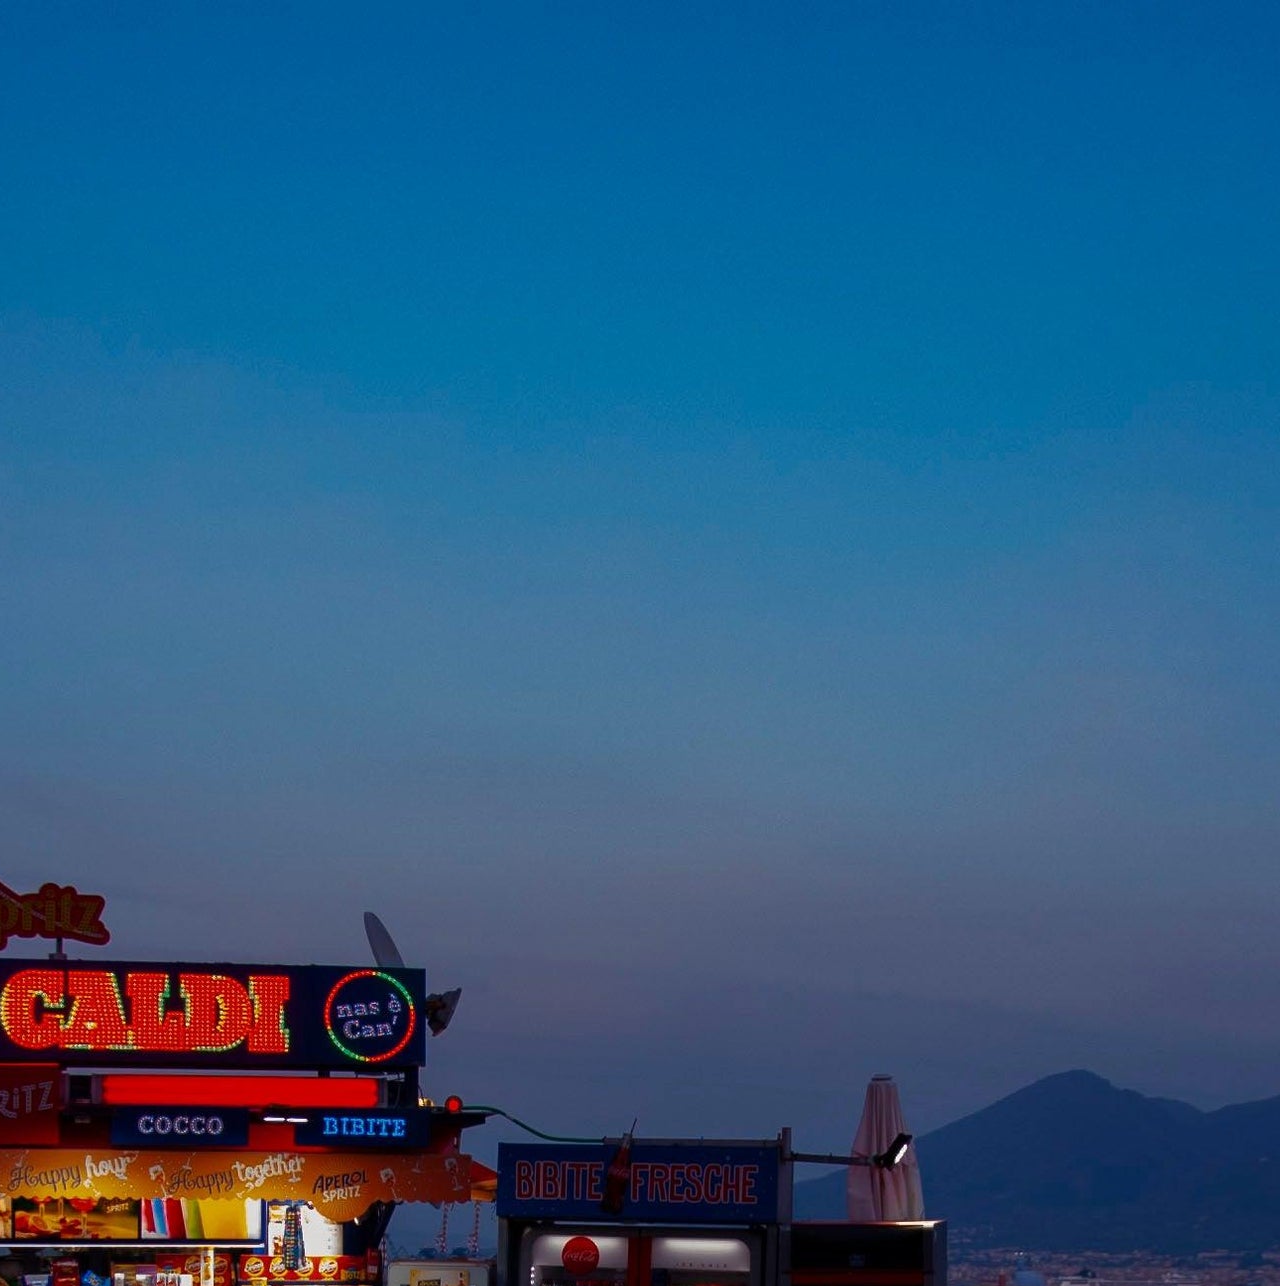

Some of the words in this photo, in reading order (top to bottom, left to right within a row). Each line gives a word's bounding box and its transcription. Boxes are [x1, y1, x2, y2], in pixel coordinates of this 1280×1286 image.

[0, 969, 291, 1053] CALDI
[336, 1001, 380, 1018] nas
[137, 1114, 225, 1135] COCCO
[321, 1116, 408, 1138] BIBITE
[6, 1163, 82, 1191] Happy
[84, 1154, 131, 1181] hour
[170, 1168, 233, 1194] Happy
[232, 1154, 306, 1187] together
[313, 1170, 370, 1194] APEROL
[515, 1159, 604, 1201] BIBITE
[630, 1161, 759, 1205] FRESCHE
